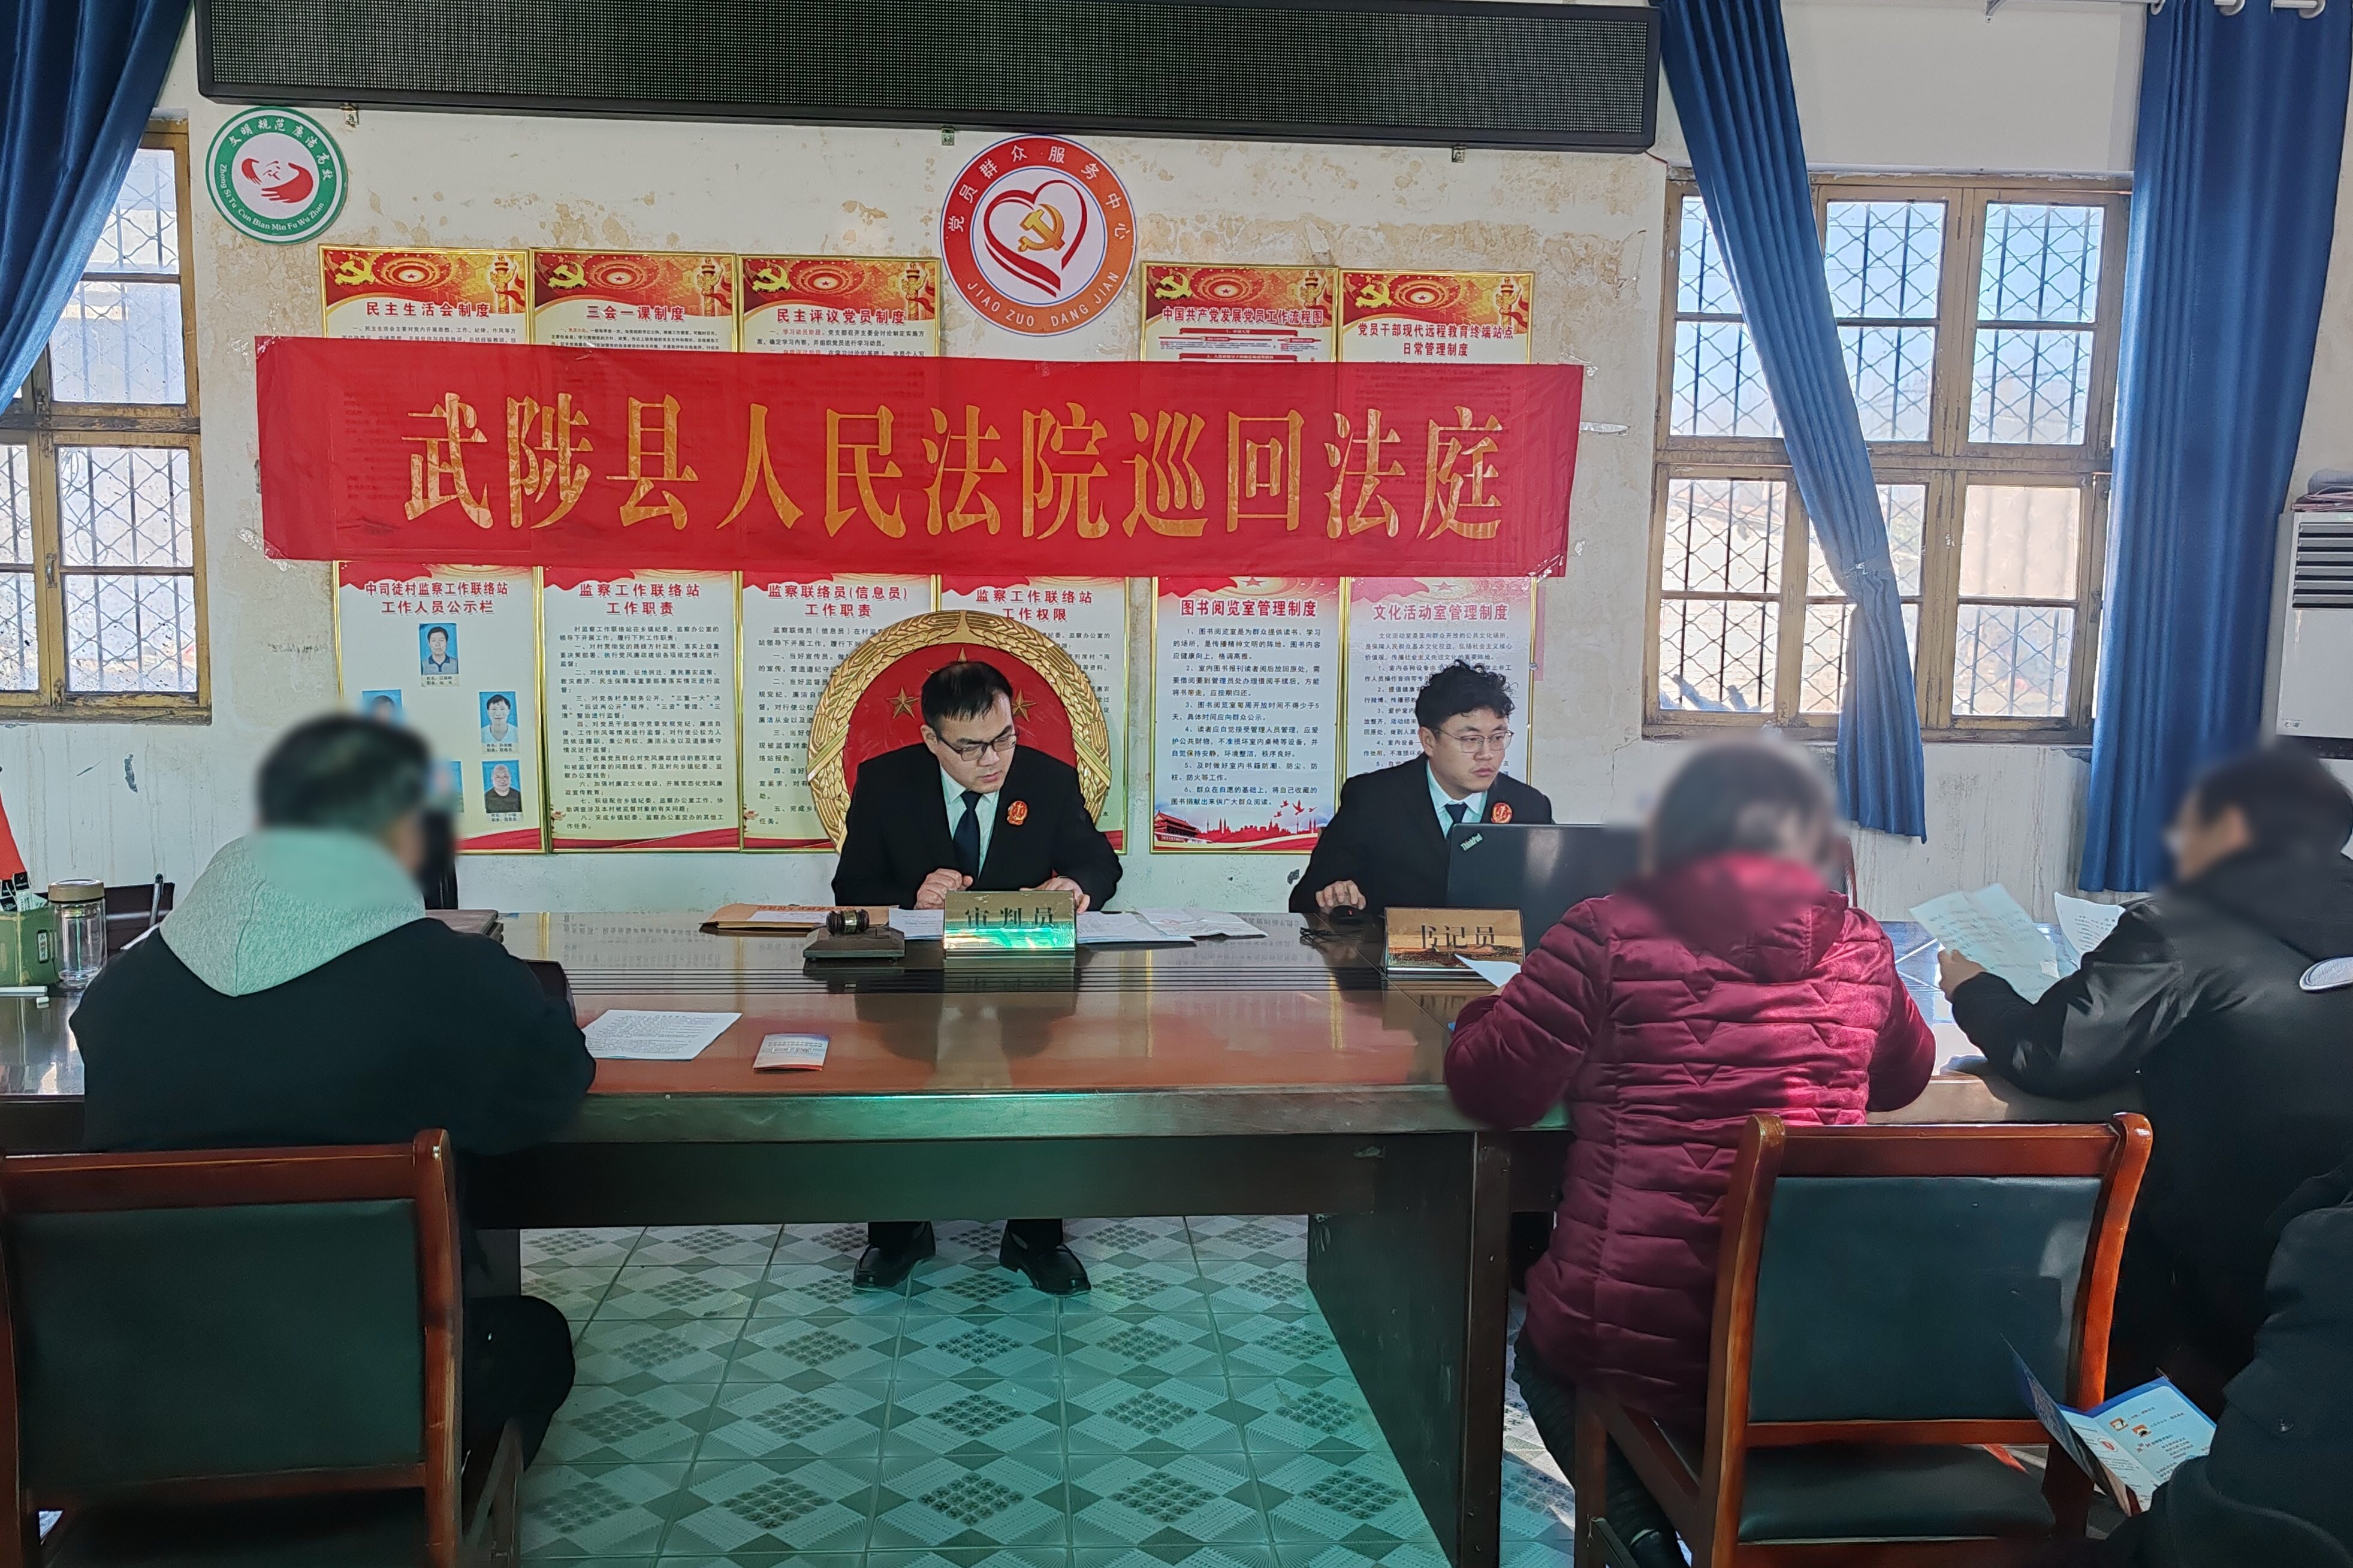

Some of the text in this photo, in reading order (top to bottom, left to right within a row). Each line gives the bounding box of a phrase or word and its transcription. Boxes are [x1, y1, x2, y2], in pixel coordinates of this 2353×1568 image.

[948, 145, 1131, 240] 党员群众服务中心
[229, 198, 237, 208] Tu
[238, 209, 252, 222] Cun
[253, 218, 270, 229] Bian
[272, 223, 286, 231] Min
[298, 216, 310, 226] Wu
[309, 203, 324, 219] Zhan
[967, 271, 1119, 327] JIAO ZUO DANG JIAN
[367, 301, 490, 318] 民主生活会制度
[586, 306, 685, 321] 三会一课制度
[777, 309, 906, 324] 民主评议党员制度
[1163, 306, 1323, 324] 中国共产党发展党员工作流程图
[1358, 324, 1513, 339] 党员干部现代远程教育终端站点
[1404, 343, 1468, 356] 日常管理制度
[400, 391, 1503, 542] 武陟县人民法院巡回法庭
[366, 582, 508, 597] 中司徒村监察工作联络站
[579, 583, 701, 598] 监察工作联络站
[976, 590, 1093, 604] 监察工作联络站
[382, 600, 494, 614] 工作人员公示栏
[607, 601, 674, 616] 工作职责
[805, 603, 872, 617] 工作职责
[1181, 600, 1317, 617] 图书阅览室管理制度
[1373, 604, 1509, 621] 文化活动室管理制度
[1003, 608, 1067, 622] 工作权限
[1416, 925, 1495, 950] 书记员
